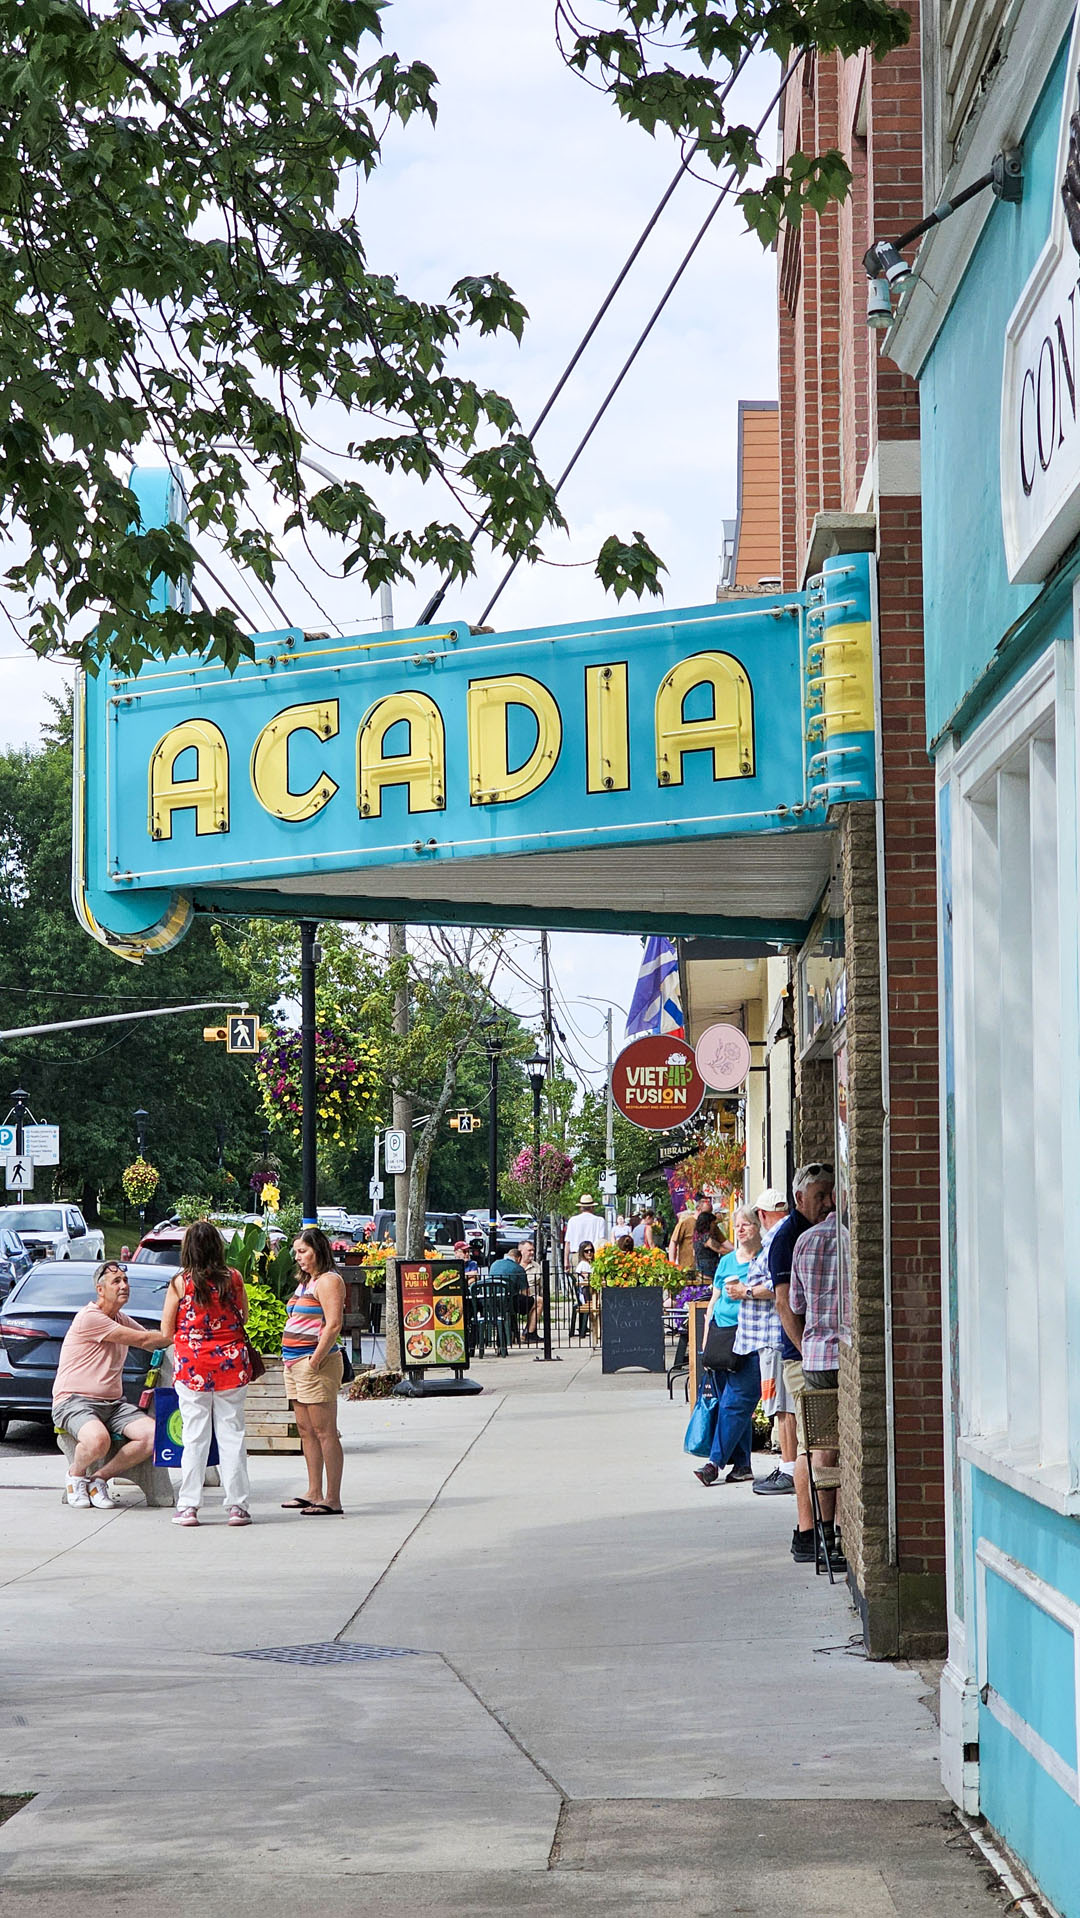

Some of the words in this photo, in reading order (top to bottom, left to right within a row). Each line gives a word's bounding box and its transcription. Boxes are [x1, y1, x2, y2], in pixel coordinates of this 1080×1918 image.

[147, 649, 756, 842] ACADIA
[626, 1066, 668, 1086] VIET
[625, 1088, 687, 1104] FUSION
[404, 1272, 420, 1281] VIET
